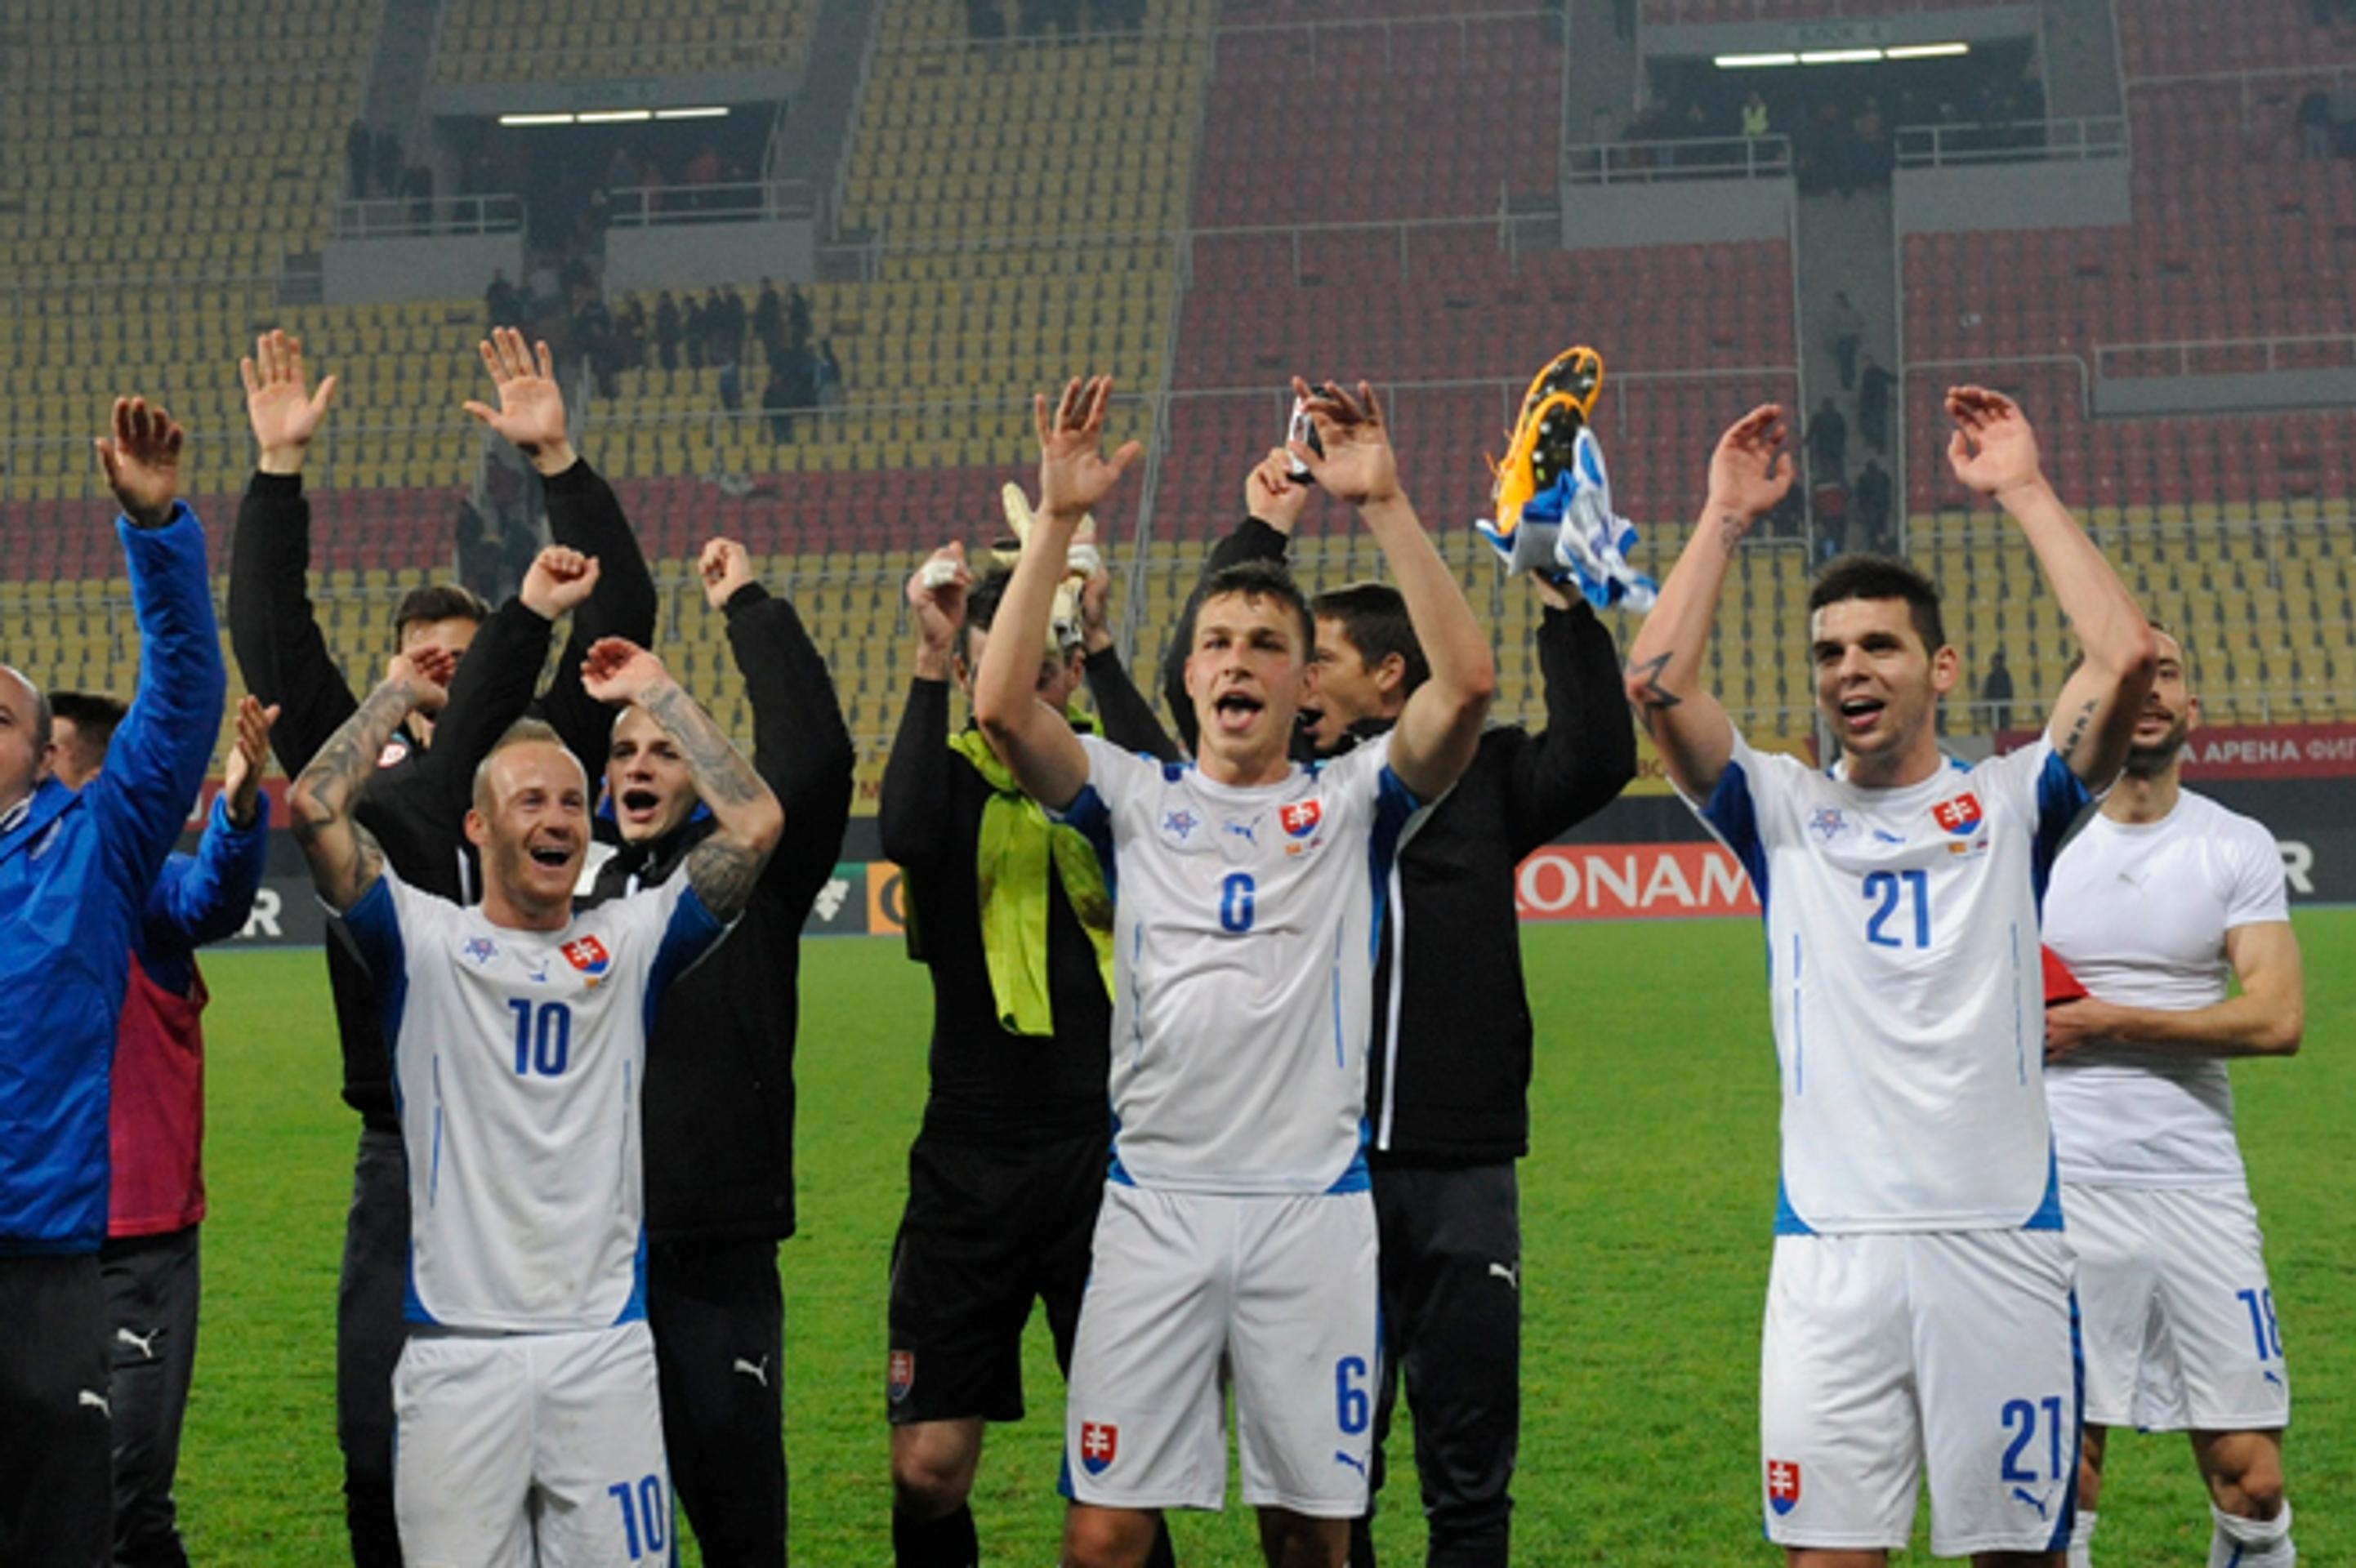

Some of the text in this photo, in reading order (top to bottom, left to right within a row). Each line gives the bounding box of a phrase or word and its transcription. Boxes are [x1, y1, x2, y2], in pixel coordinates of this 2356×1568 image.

[1515, 853, 1761, 911] ONAM
[1862, 869, 1930, 949] 21
[508, 997, 571, 1077] 10
[1336, 1356, 1368, 1435] 6
[2001, 1396, 2061, 1482] 21
[608, 1474, 664, 1562] 10
